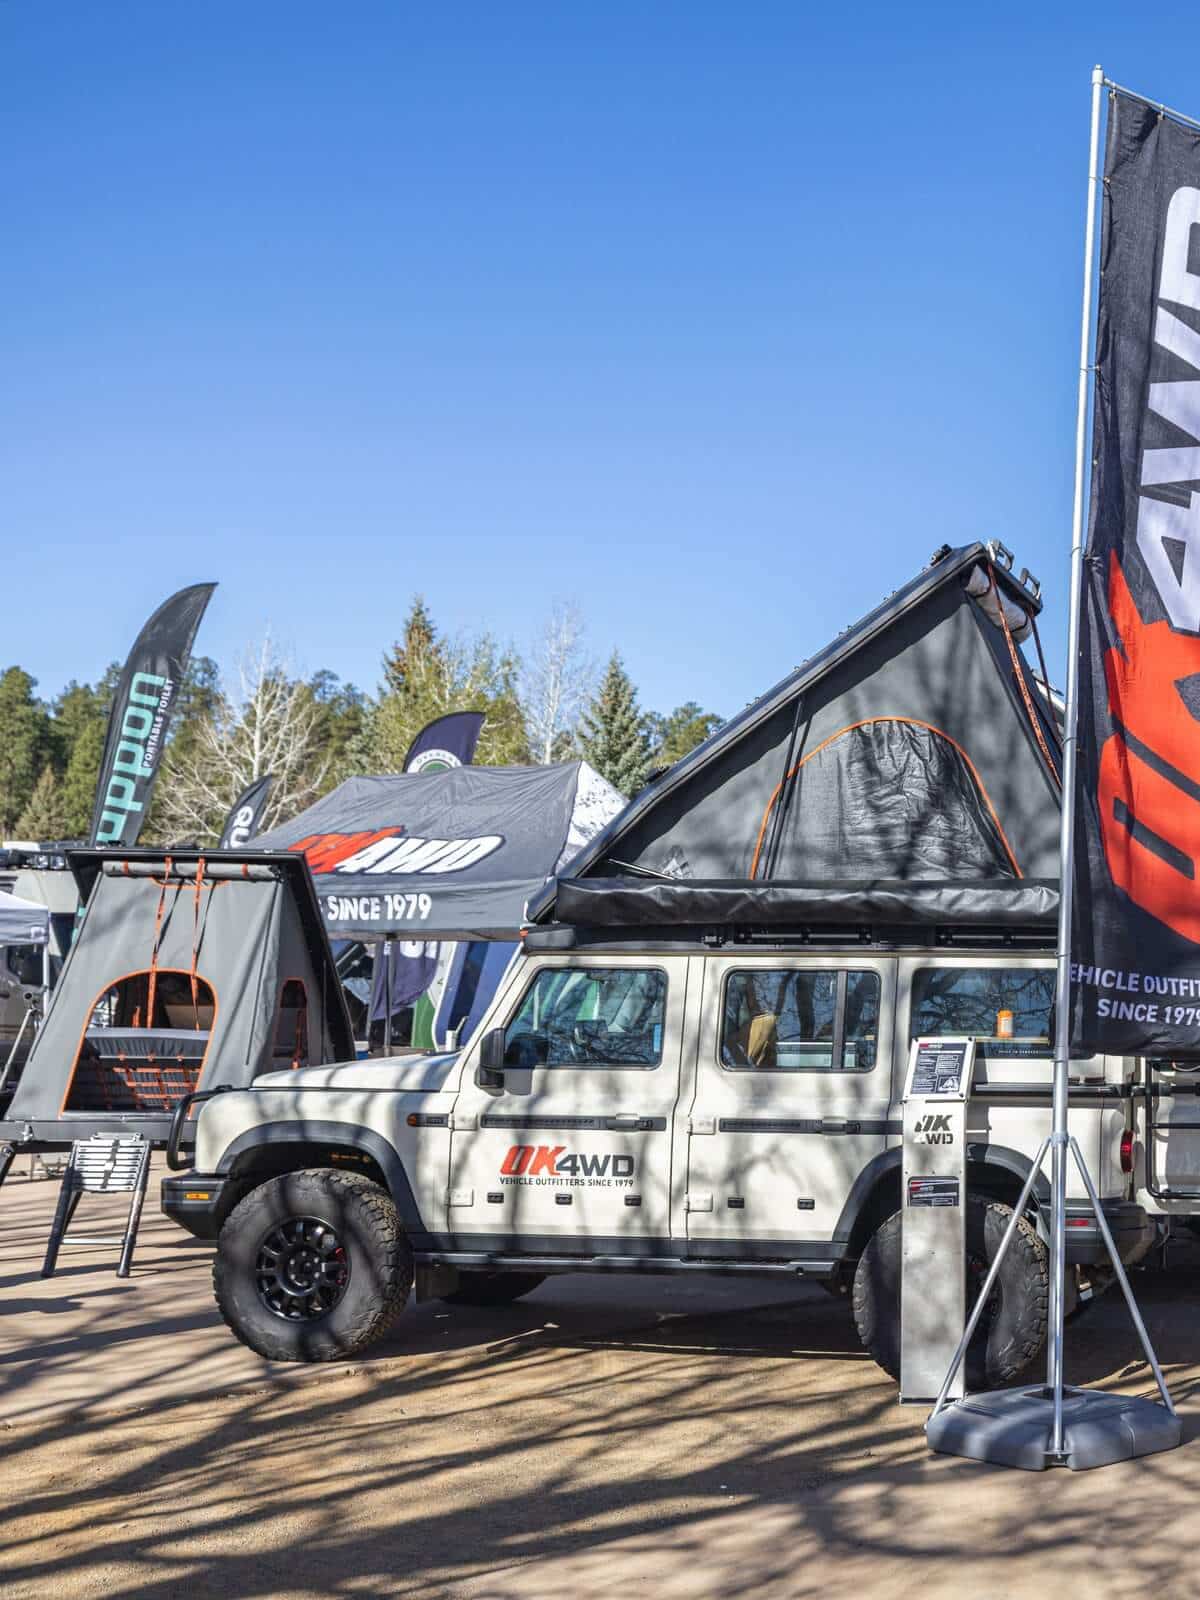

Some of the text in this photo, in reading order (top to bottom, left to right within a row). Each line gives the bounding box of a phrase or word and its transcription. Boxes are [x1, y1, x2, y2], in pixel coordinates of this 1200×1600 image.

[143, 678, 175, 769] PORTABLE TOILET
[327, 893, 432, 921] SINCE 1979
[1068, 962, 1140, 992] EHICLE
[1097, 998, 1157, 1023] SINCE
[500, 1145, 635, 1177] OK4WD
[500, 1177, 634, 1188] VEHICLE OUTFITTERS SINCE 1979
